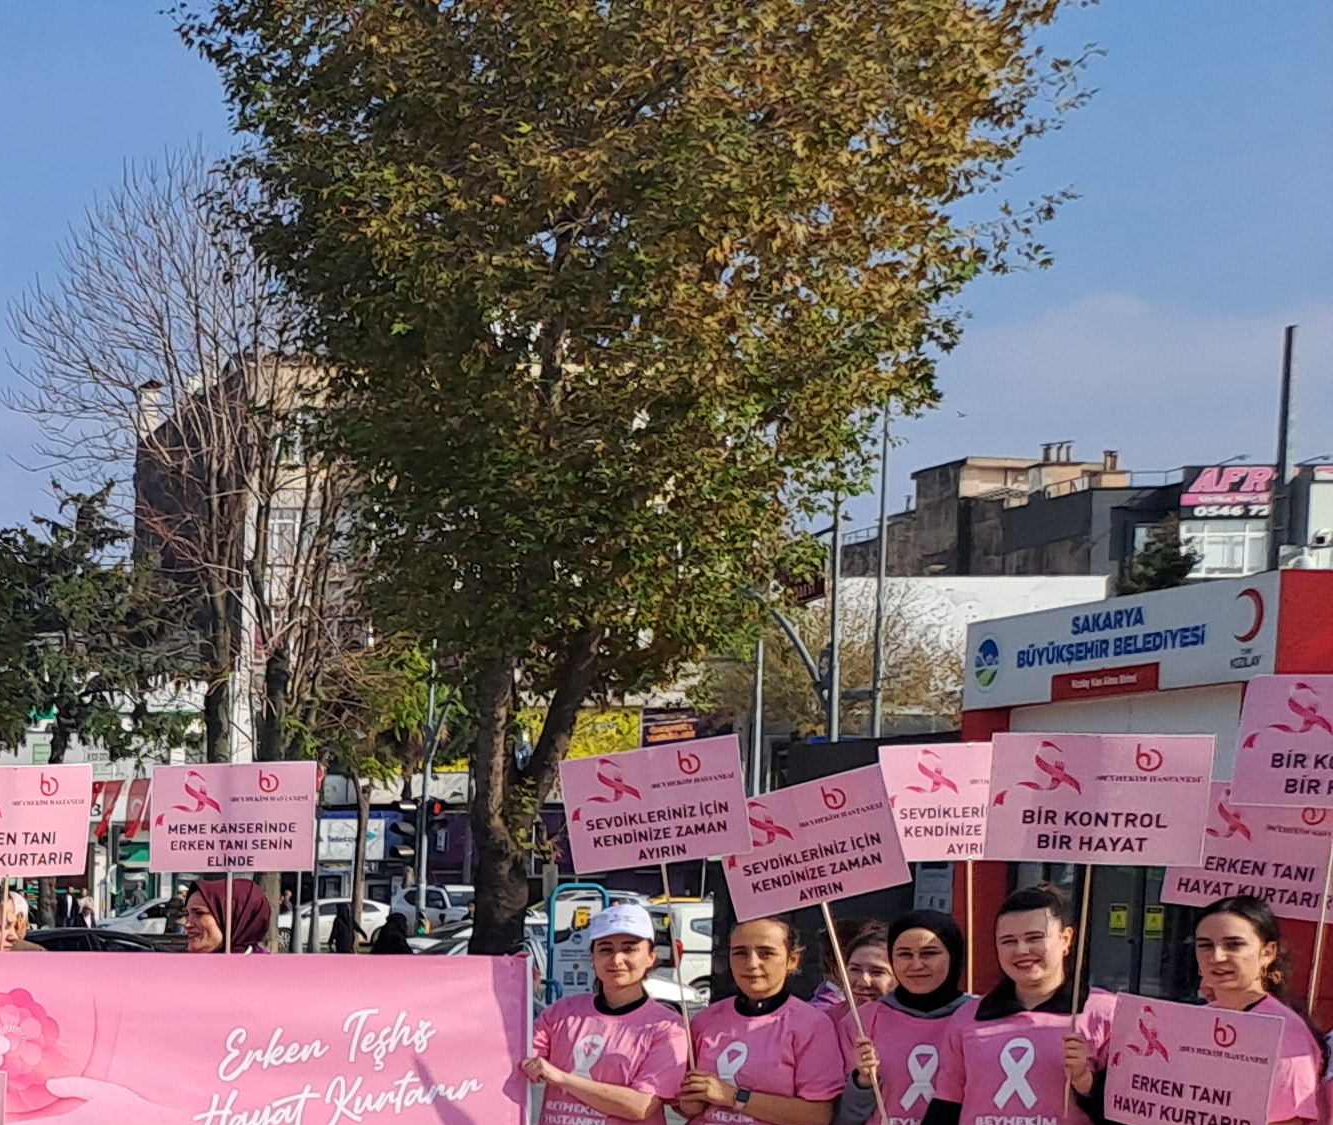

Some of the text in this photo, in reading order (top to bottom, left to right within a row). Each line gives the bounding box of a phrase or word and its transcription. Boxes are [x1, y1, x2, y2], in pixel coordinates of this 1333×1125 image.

[1071, 606, 1145, 635] SAKARYA
[1016, 624, 1207, 669] BÜYÜKŞEHİR BELEDİYESİ
[1271, 749, 1307, 769] BİR
[1284, 775, 1320, 795] BİR
[585, 799, 729, 832] SEVDİKLERİNİZ İÇİN
[899, 803, 986, 821] SEVDİKLERİ
[1021, 806, 1168, 830] BİR KONTROL
[167, 818, 297, 836] MEME KANSERİNDE
[592, 820, 728, 849] KENDİNİZE ZAMAN
[903, 820, 983, 838] KENDİNİZE
[22, 830, 57, 846] TANI
[170, 835, 293, 852] ERKEN TANI SENİN
[1037, 832, 1148, 853] BİR HAYAT
[206, 852, 254, 867] ELİNDE
[638, 843, 687, 862] AYIRIN
[742, 831, 882, 877] SEVDİKLERİNİZ İÇİN
[947, 842, 984, 856] AYIRI
[751, 851, 883, 894] KENDİNİZE ZAMAN
[1204, 856, 1315, 882] ERKEN TANI
[798, 880, 844, 902] AYIRIN
[1176, 878, 1233, 897] HAYAT
[217, 1008, 438, 1082] Erken Teşhis
[1131, 1074, 1232, 1107] ERKEN TANI
[1113, 1094, 1156, 1118] HAYAT
